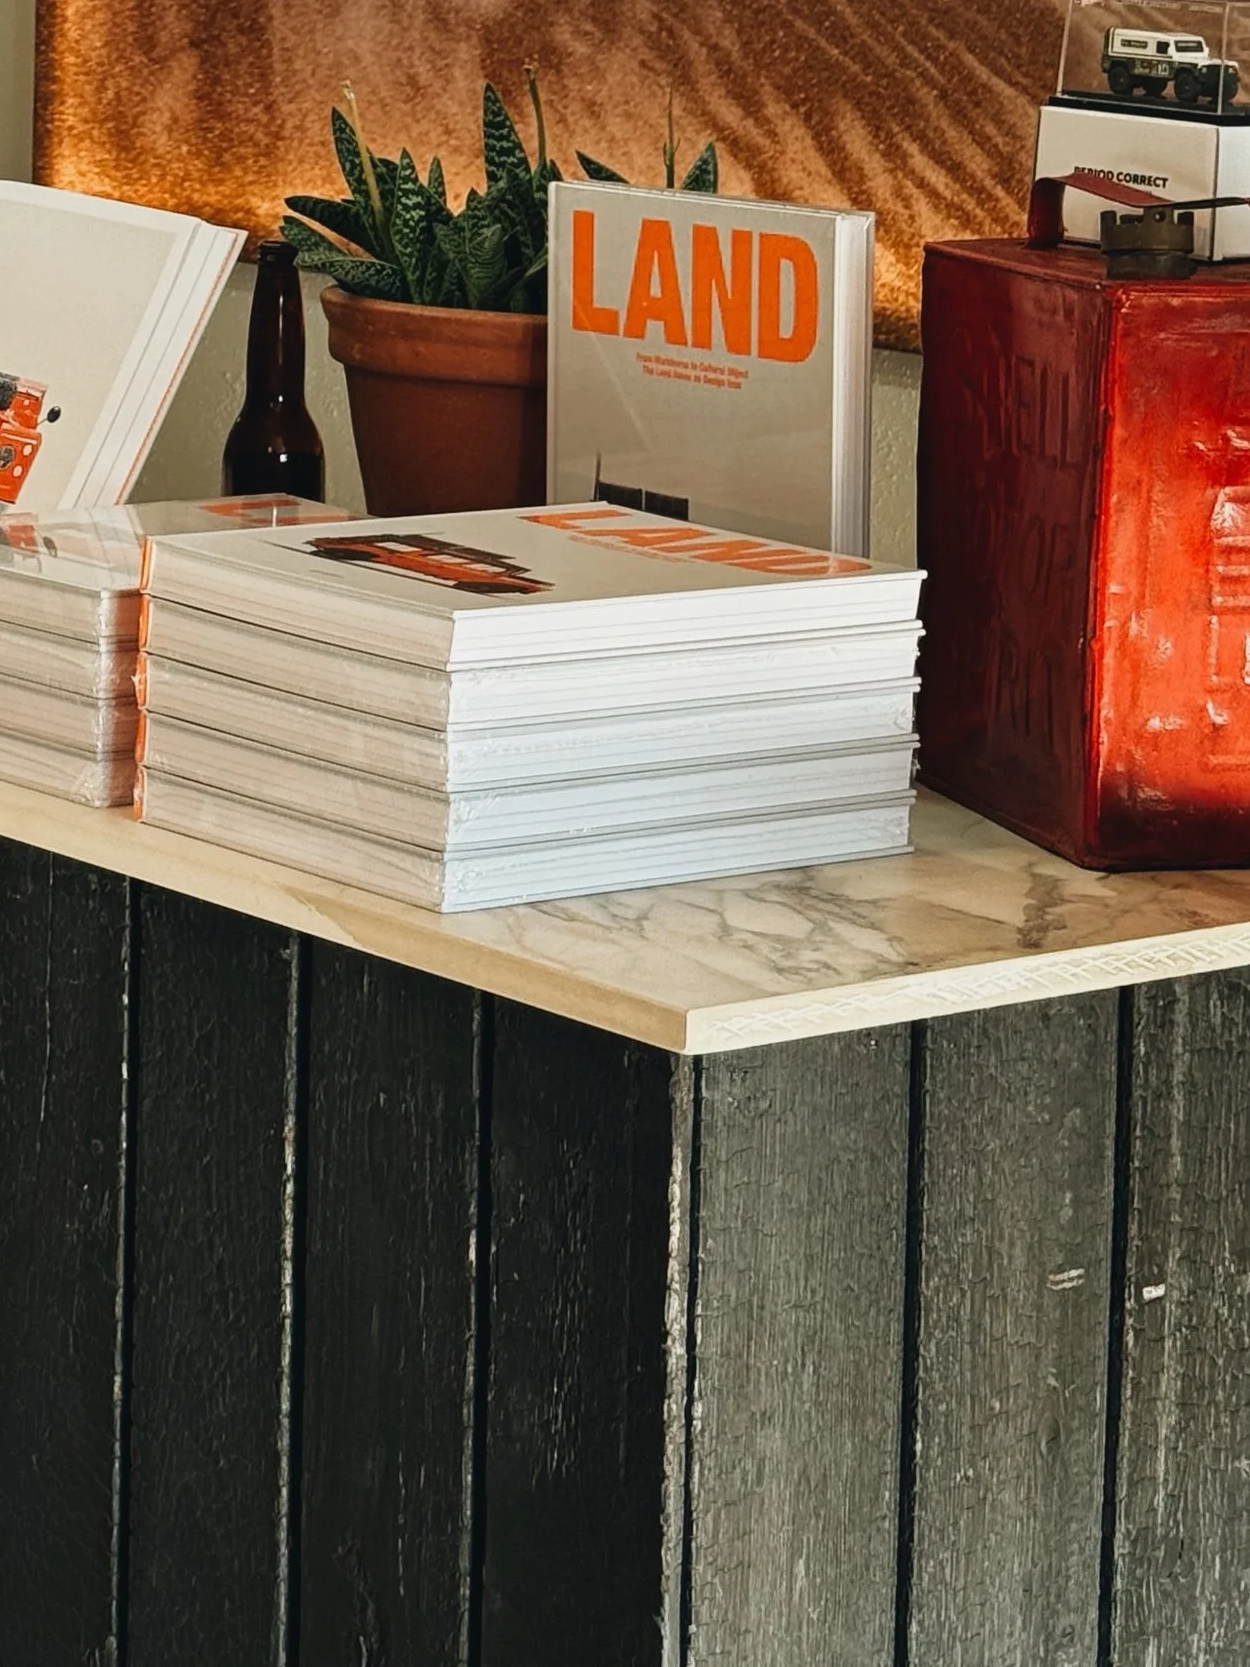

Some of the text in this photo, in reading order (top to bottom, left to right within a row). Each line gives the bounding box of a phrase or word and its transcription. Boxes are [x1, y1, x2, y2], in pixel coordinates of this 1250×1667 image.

[1116, 171, 1169, 188] CORRECT
[572, 209, 818, 362] LAND
[517, 509, 874, 575] LAND
